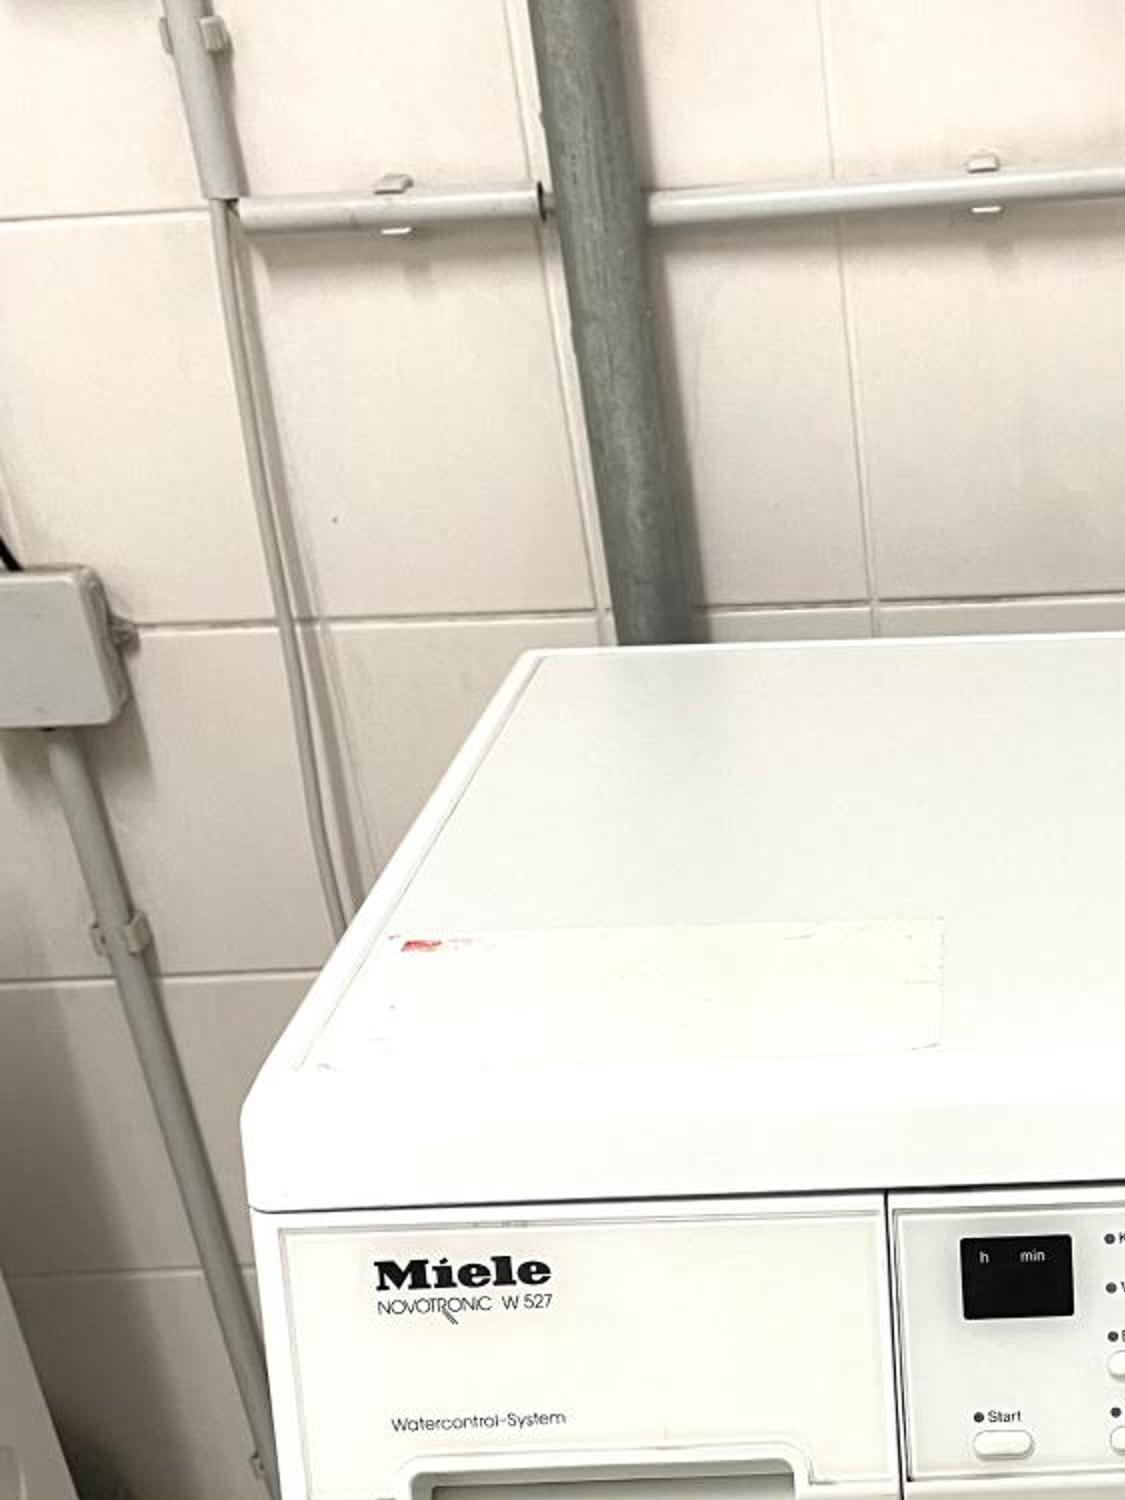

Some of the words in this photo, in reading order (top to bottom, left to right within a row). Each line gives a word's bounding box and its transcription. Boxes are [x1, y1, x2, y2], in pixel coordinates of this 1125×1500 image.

[979, 1250, 990, 1264] h
[1020, 1248, 1046, 1263] min
[373, 1256, 552, 1291] Miele
[377, 1296, 493, 1319] NOVOTRONIC
[501, 1295, 519, 1310] W
[523, 1293, 552, 1309] 527
[391, 1411, 567, 1432] Watercontrol-System
[987, 1410, 1022, 1423] Start
